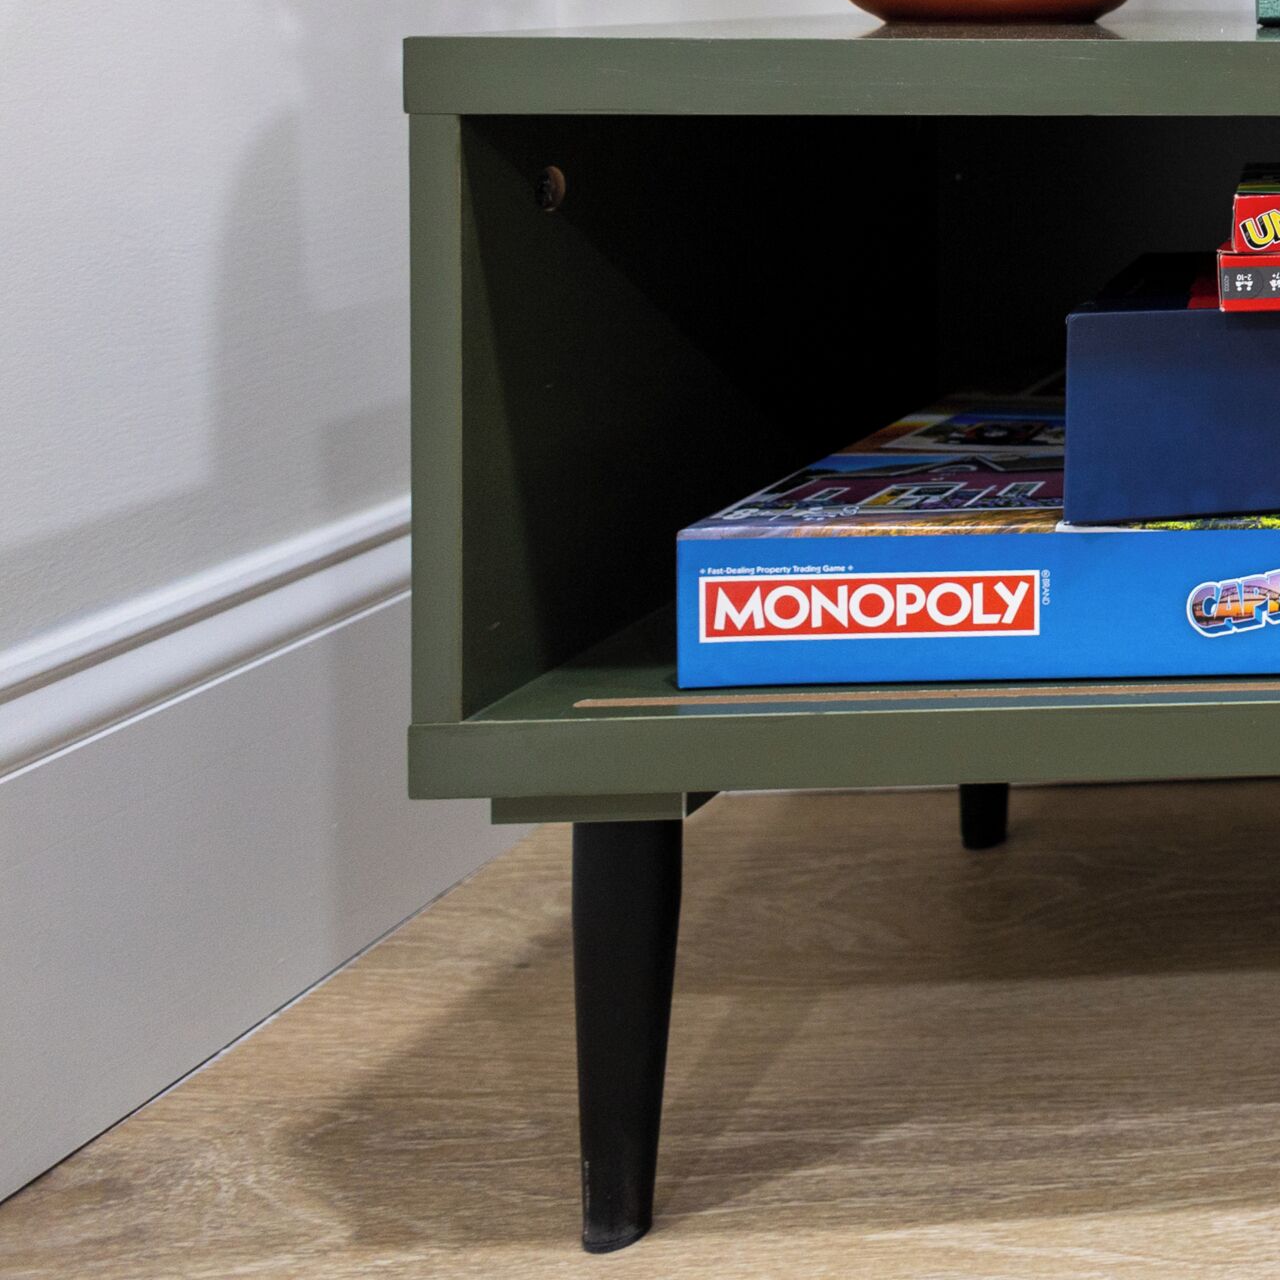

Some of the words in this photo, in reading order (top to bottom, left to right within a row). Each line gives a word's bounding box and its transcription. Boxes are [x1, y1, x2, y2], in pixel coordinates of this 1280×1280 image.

[707, 567, 755, 575] Fast-Dealing
[756, 565, 791, 574] Property
[793, 564, 821, 573] Trading
[713, 581, 1030, 631] MONOPOLY
